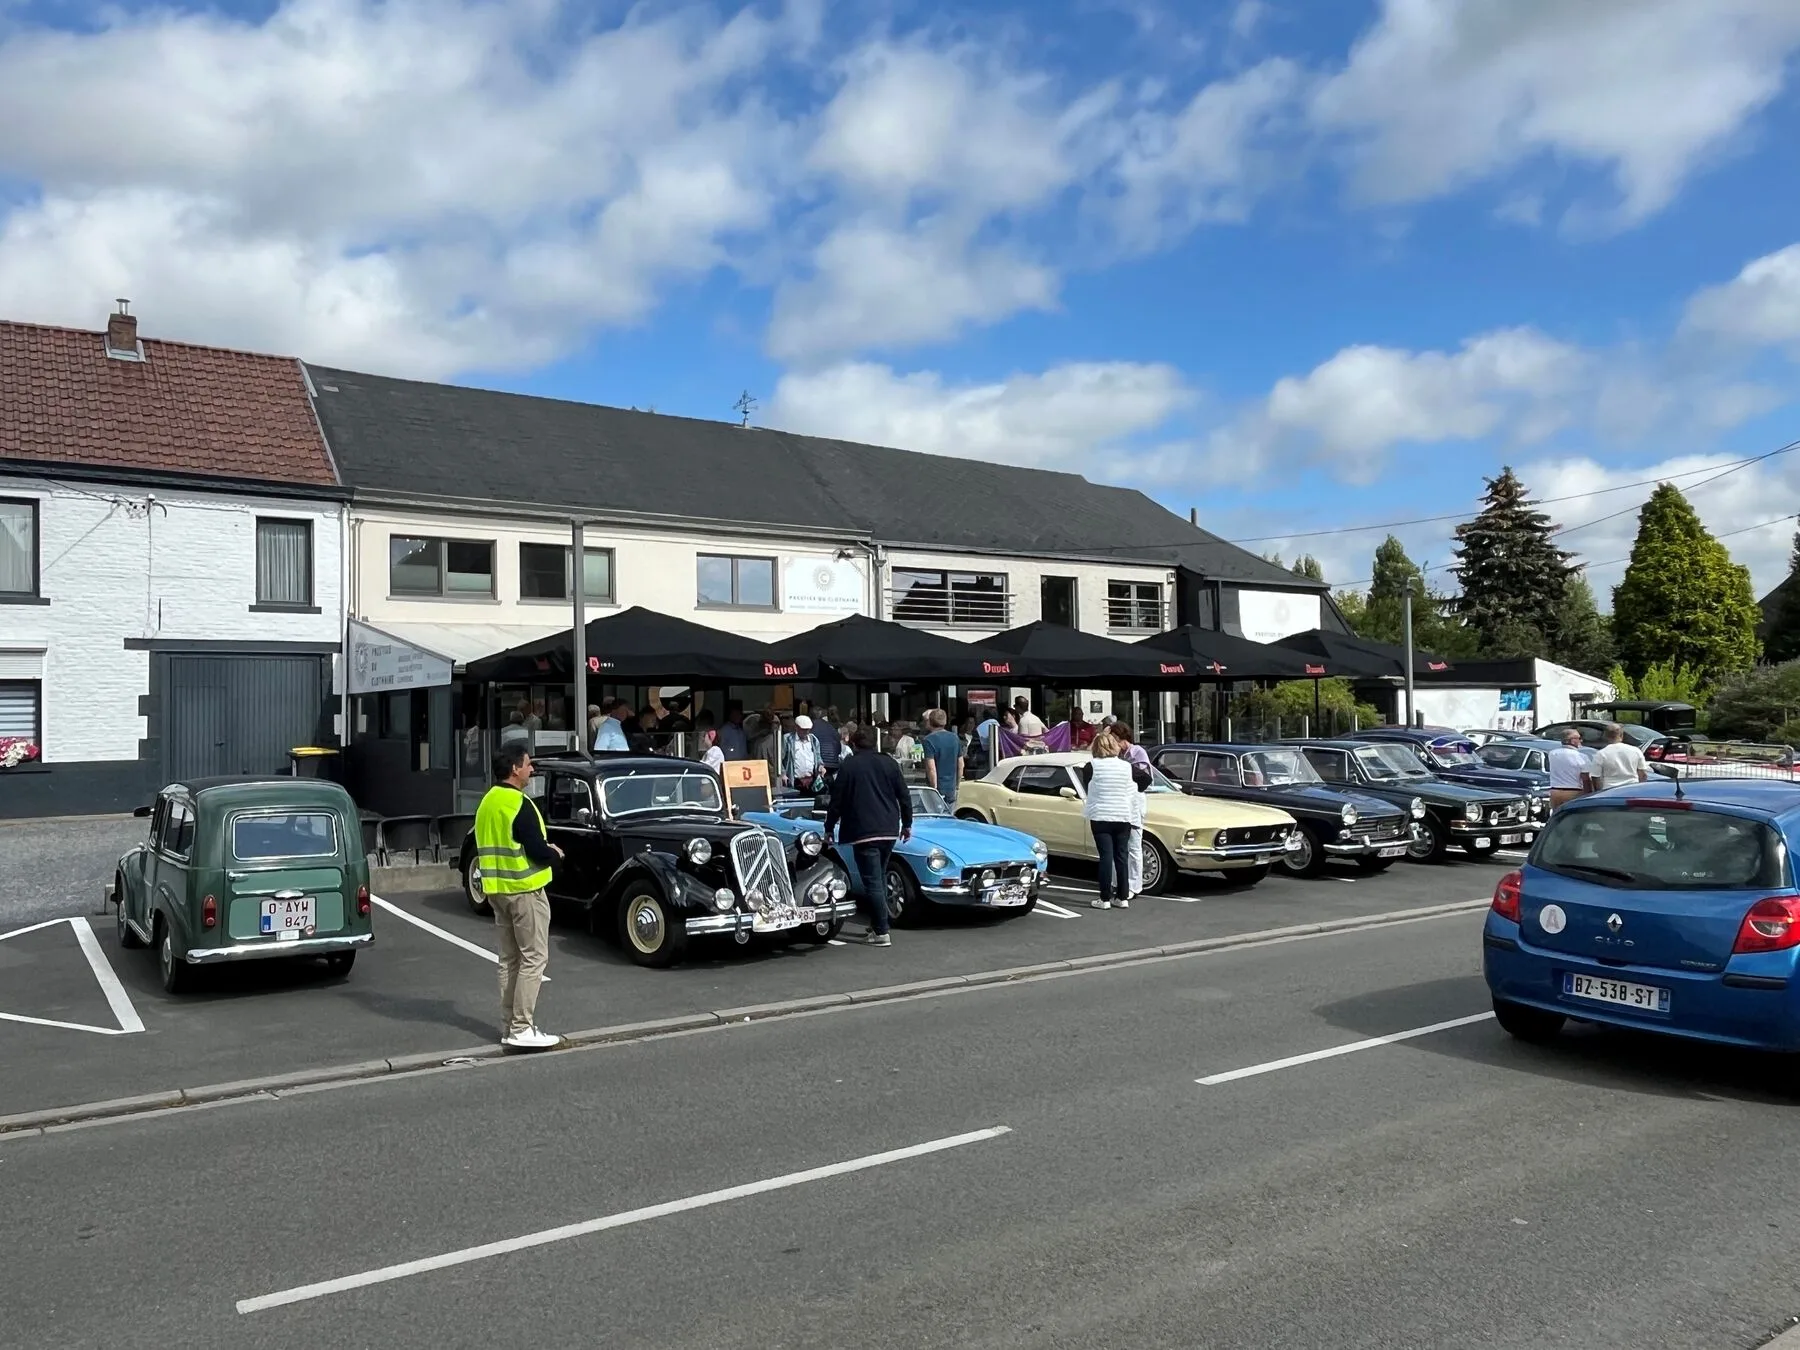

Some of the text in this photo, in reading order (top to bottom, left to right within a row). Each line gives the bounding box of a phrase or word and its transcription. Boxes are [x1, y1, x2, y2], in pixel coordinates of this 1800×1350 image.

[764, 663, 798, 675] Duvel
[983, 662, 1010, 673] Duvel
[286, 916, 308, 928] 847
